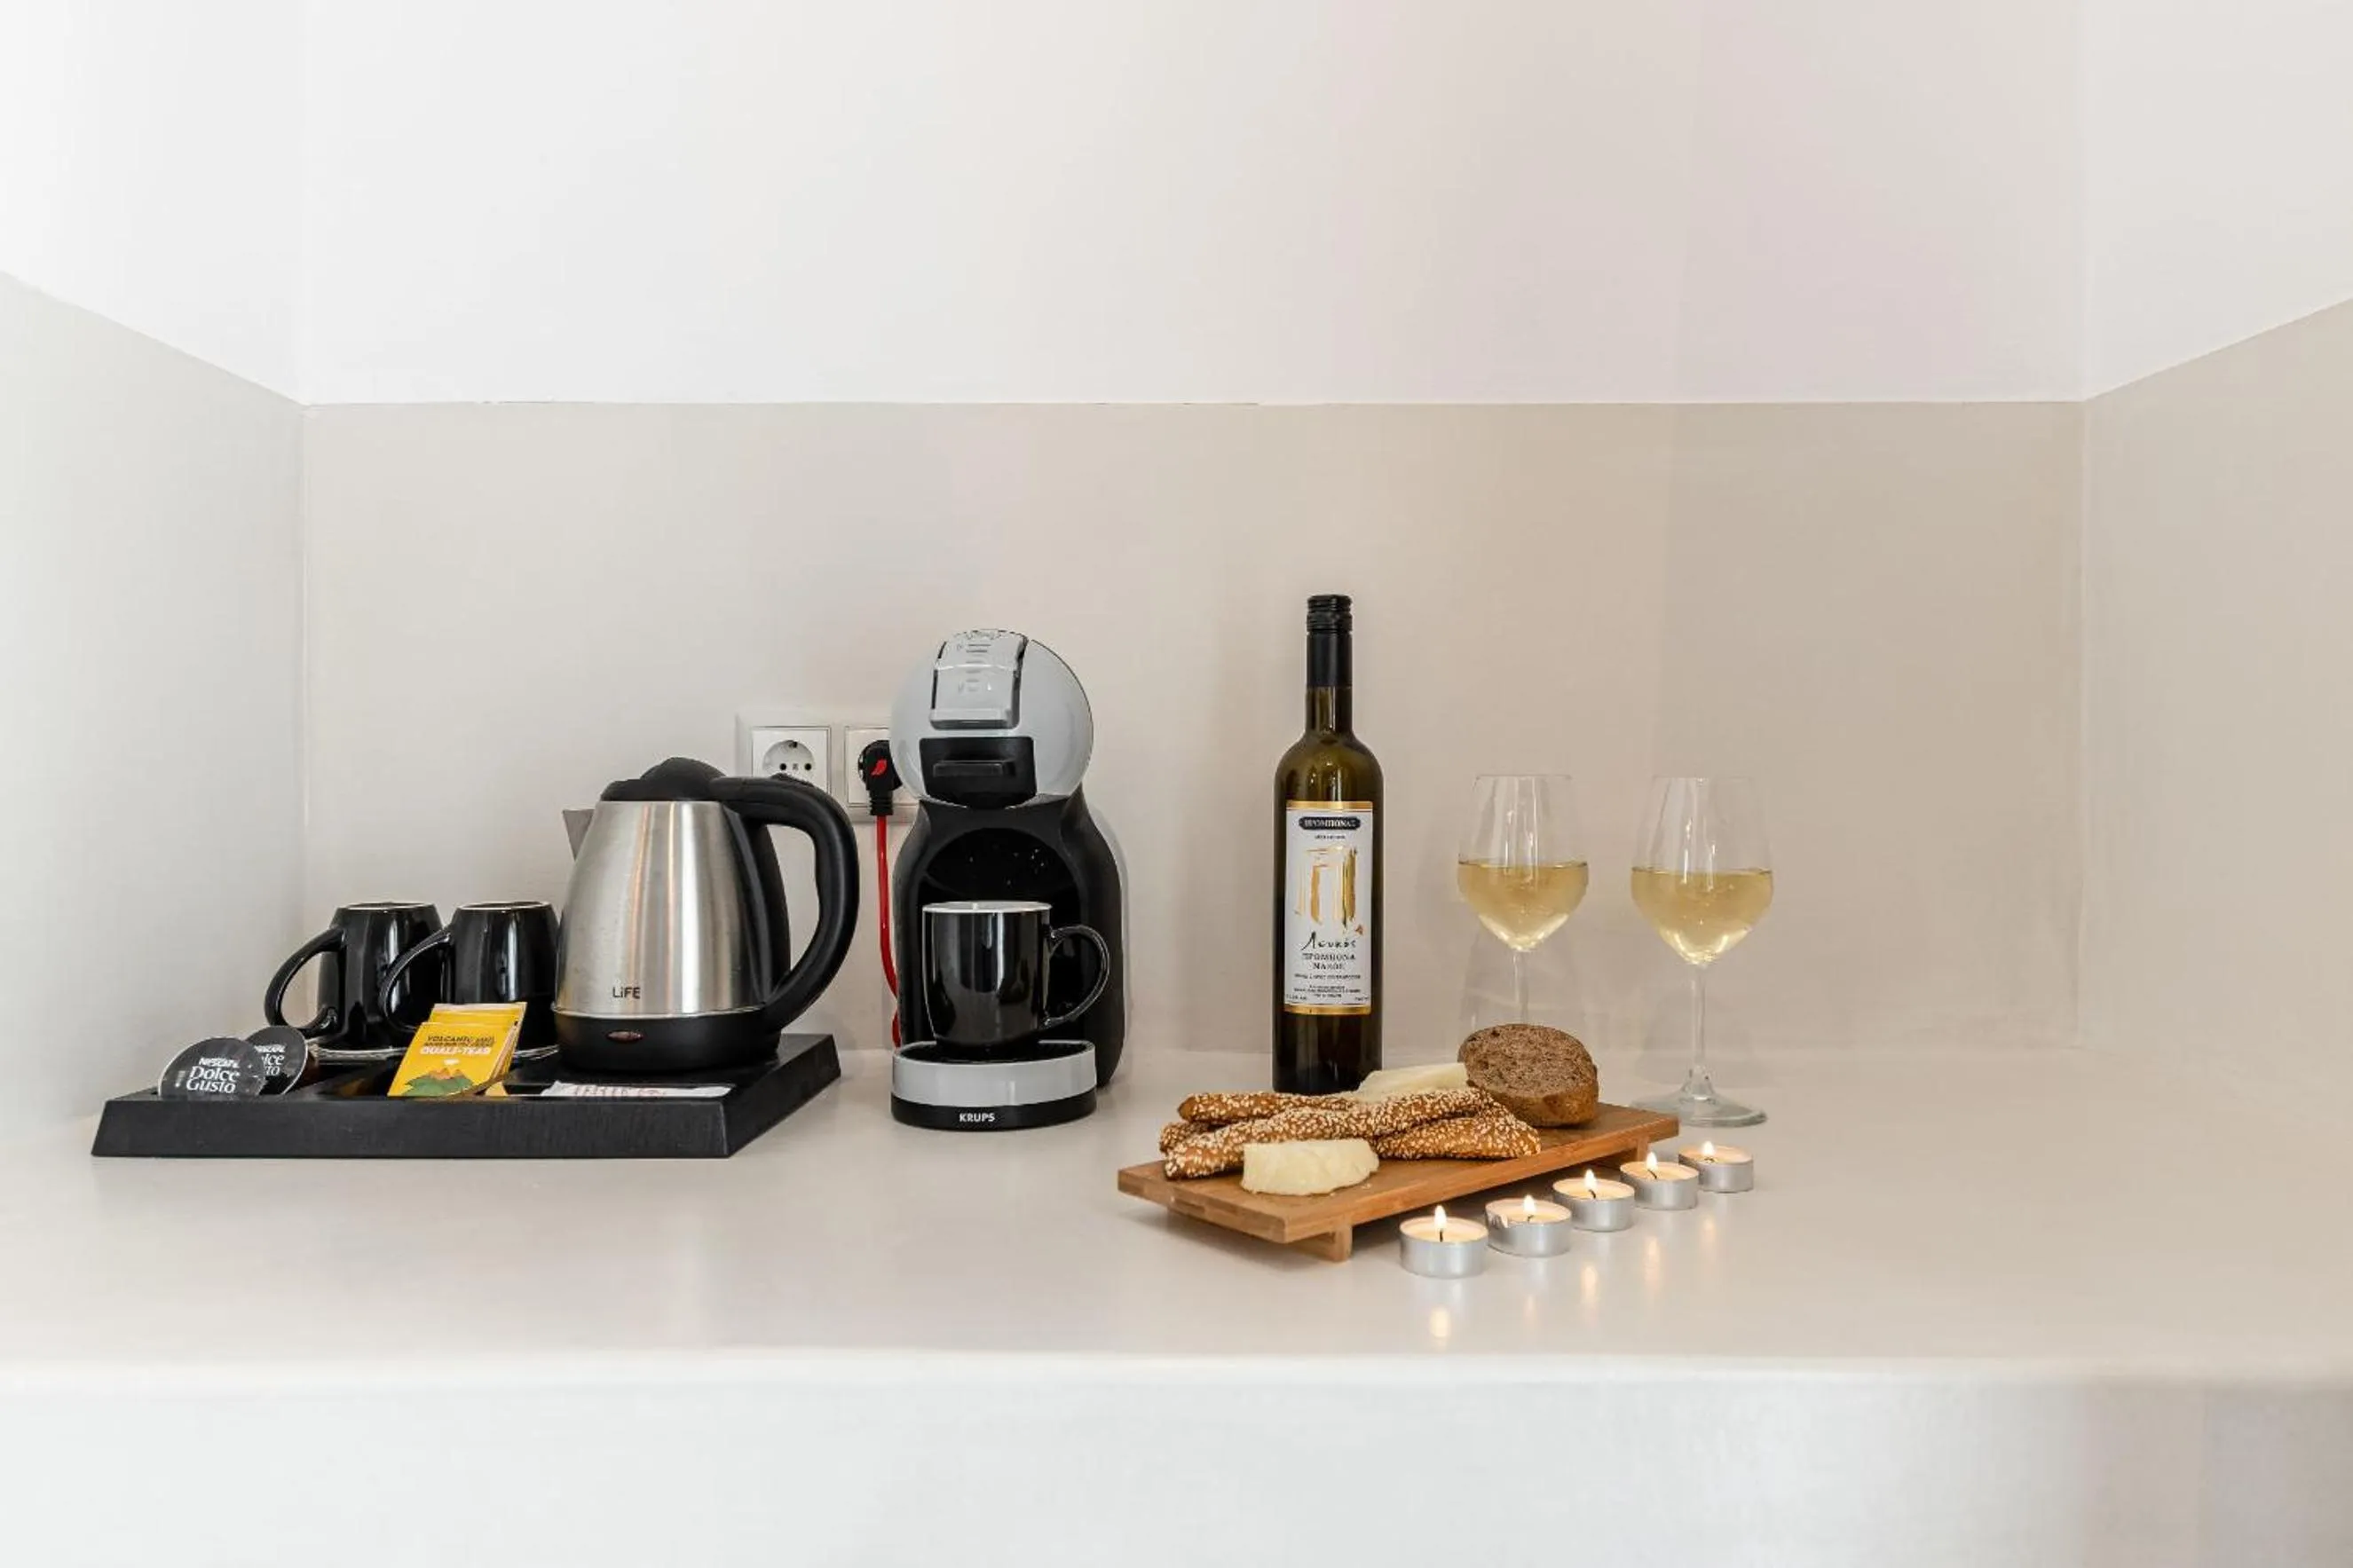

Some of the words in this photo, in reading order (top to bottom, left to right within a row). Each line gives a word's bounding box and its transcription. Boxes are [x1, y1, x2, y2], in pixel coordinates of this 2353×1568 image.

[261, 1052, 286, 1066] lce
[189, 1065, 241, 1083] Dolce
[186, 1077, 237, 1094] Gusto
[959, 1112, 996, 1123] KRUPS
